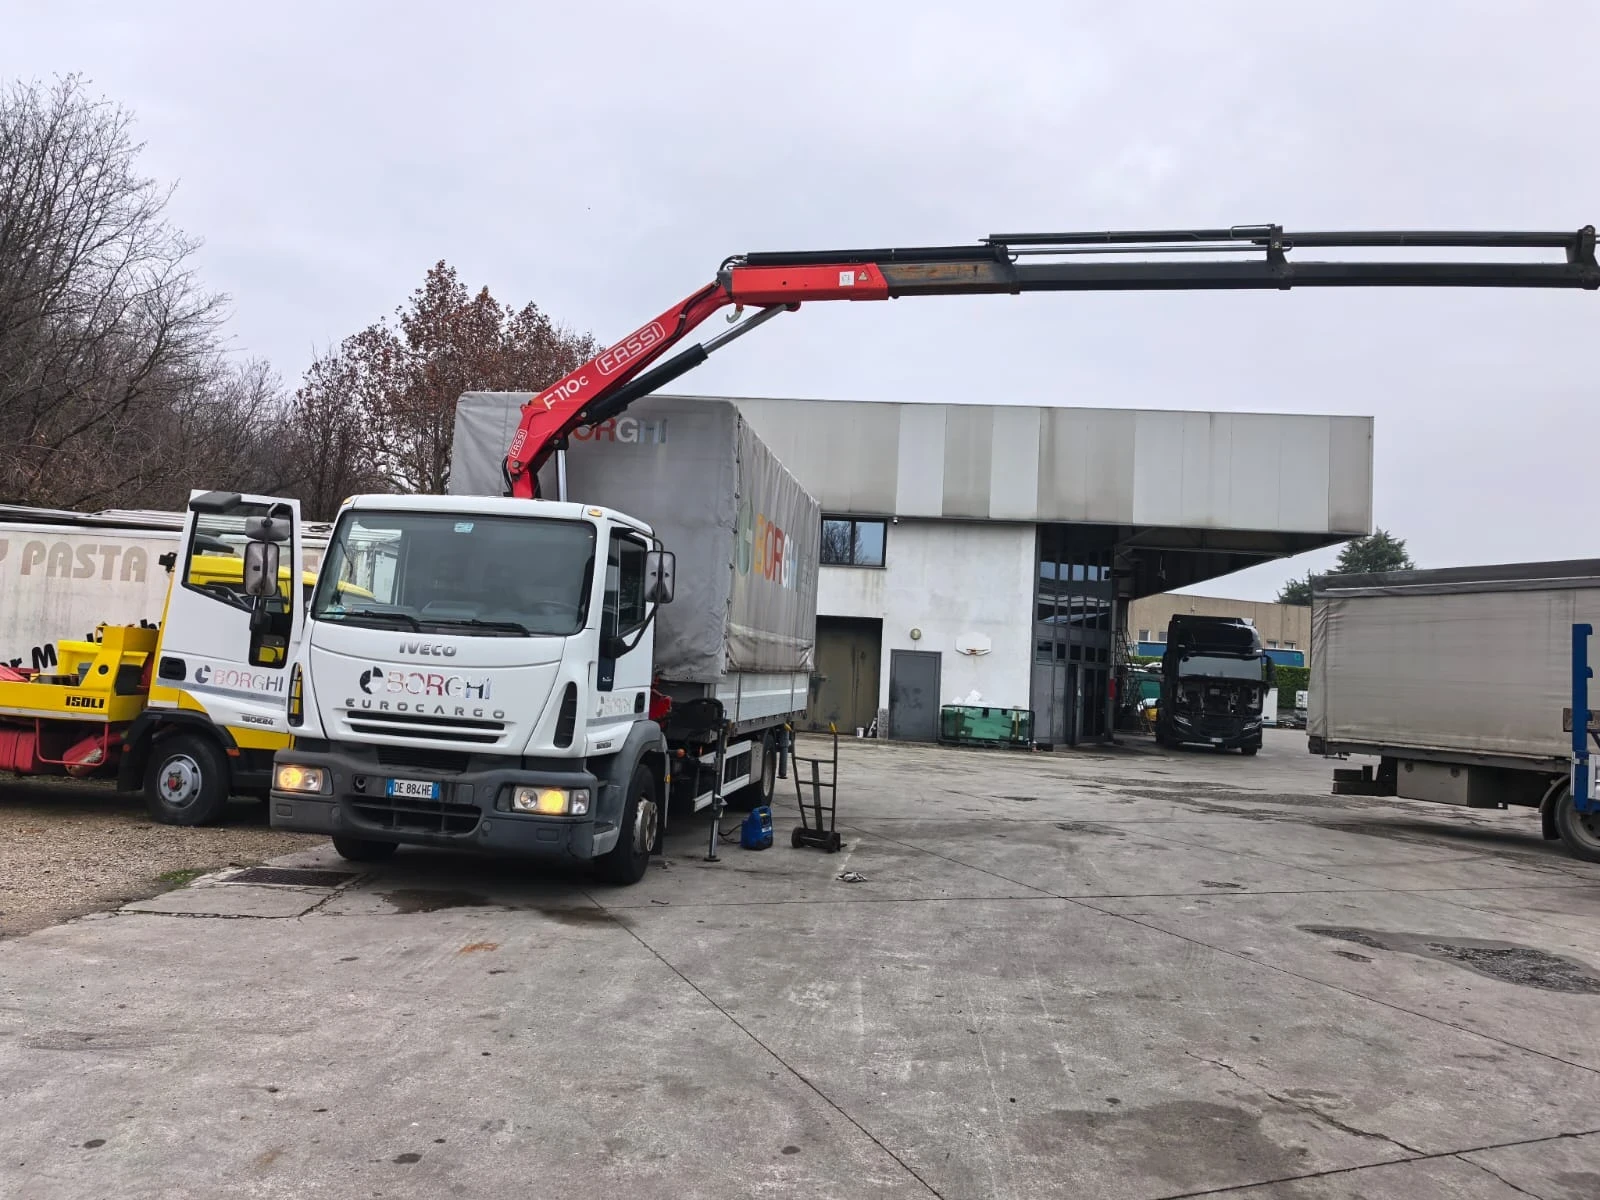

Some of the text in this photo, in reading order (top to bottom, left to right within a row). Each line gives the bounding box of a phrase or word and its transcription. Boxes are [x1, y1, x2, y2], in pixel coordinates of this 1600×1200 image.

[600, 325, 662, 372] FASSI
[572, 416, 668, 444] ORGHI
[510, 431, 527, 456] FASSI
[20, 540, 149, 582] PASTA
[399, 640, 458, 657] IVECO
[213, 668, 285, 692] BORGHI
[386, 671, 493, 700] BORGHI
[65, 695, 105, 709] ISOLI
[345, 697, 505, 719] EUROCARGO
